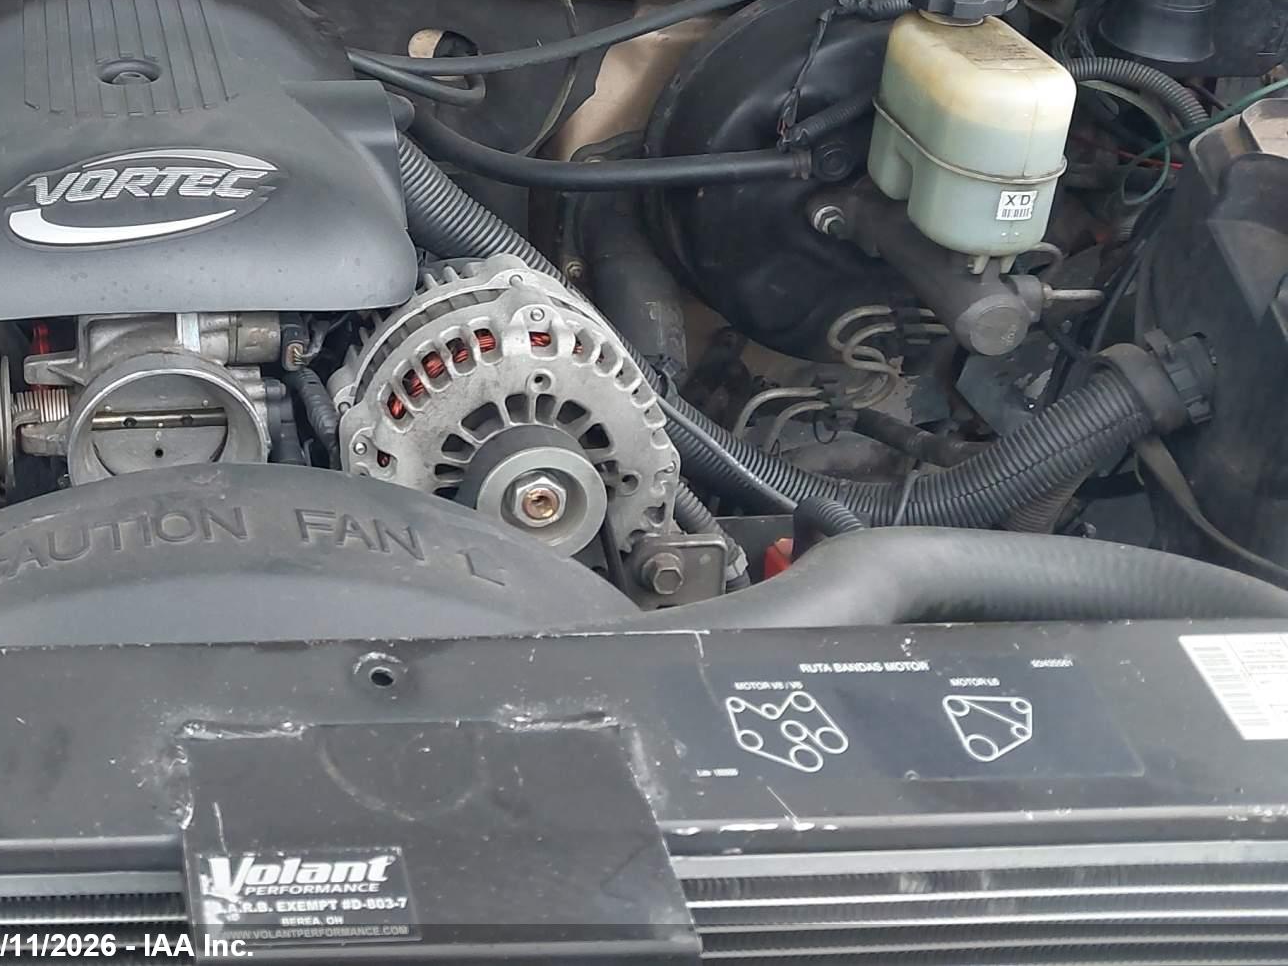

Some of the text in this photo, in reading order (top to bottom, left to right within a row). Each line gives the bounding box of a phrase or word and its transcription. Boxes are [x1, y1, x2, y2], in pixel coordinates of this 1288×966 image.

[27, 166, 269, 205] VORTEC
[295, 507, 426, 561] FAN
[798, 662, 832, 673] RUTA
[884, 659, 930, 672] MOTOR
[208, 854, 396, 897] Volant
[244, 883, 380, 896] PERFORMANCE
[276, 899, 338, 912] EXEMPT
[325, 915, 344, 925] OH
